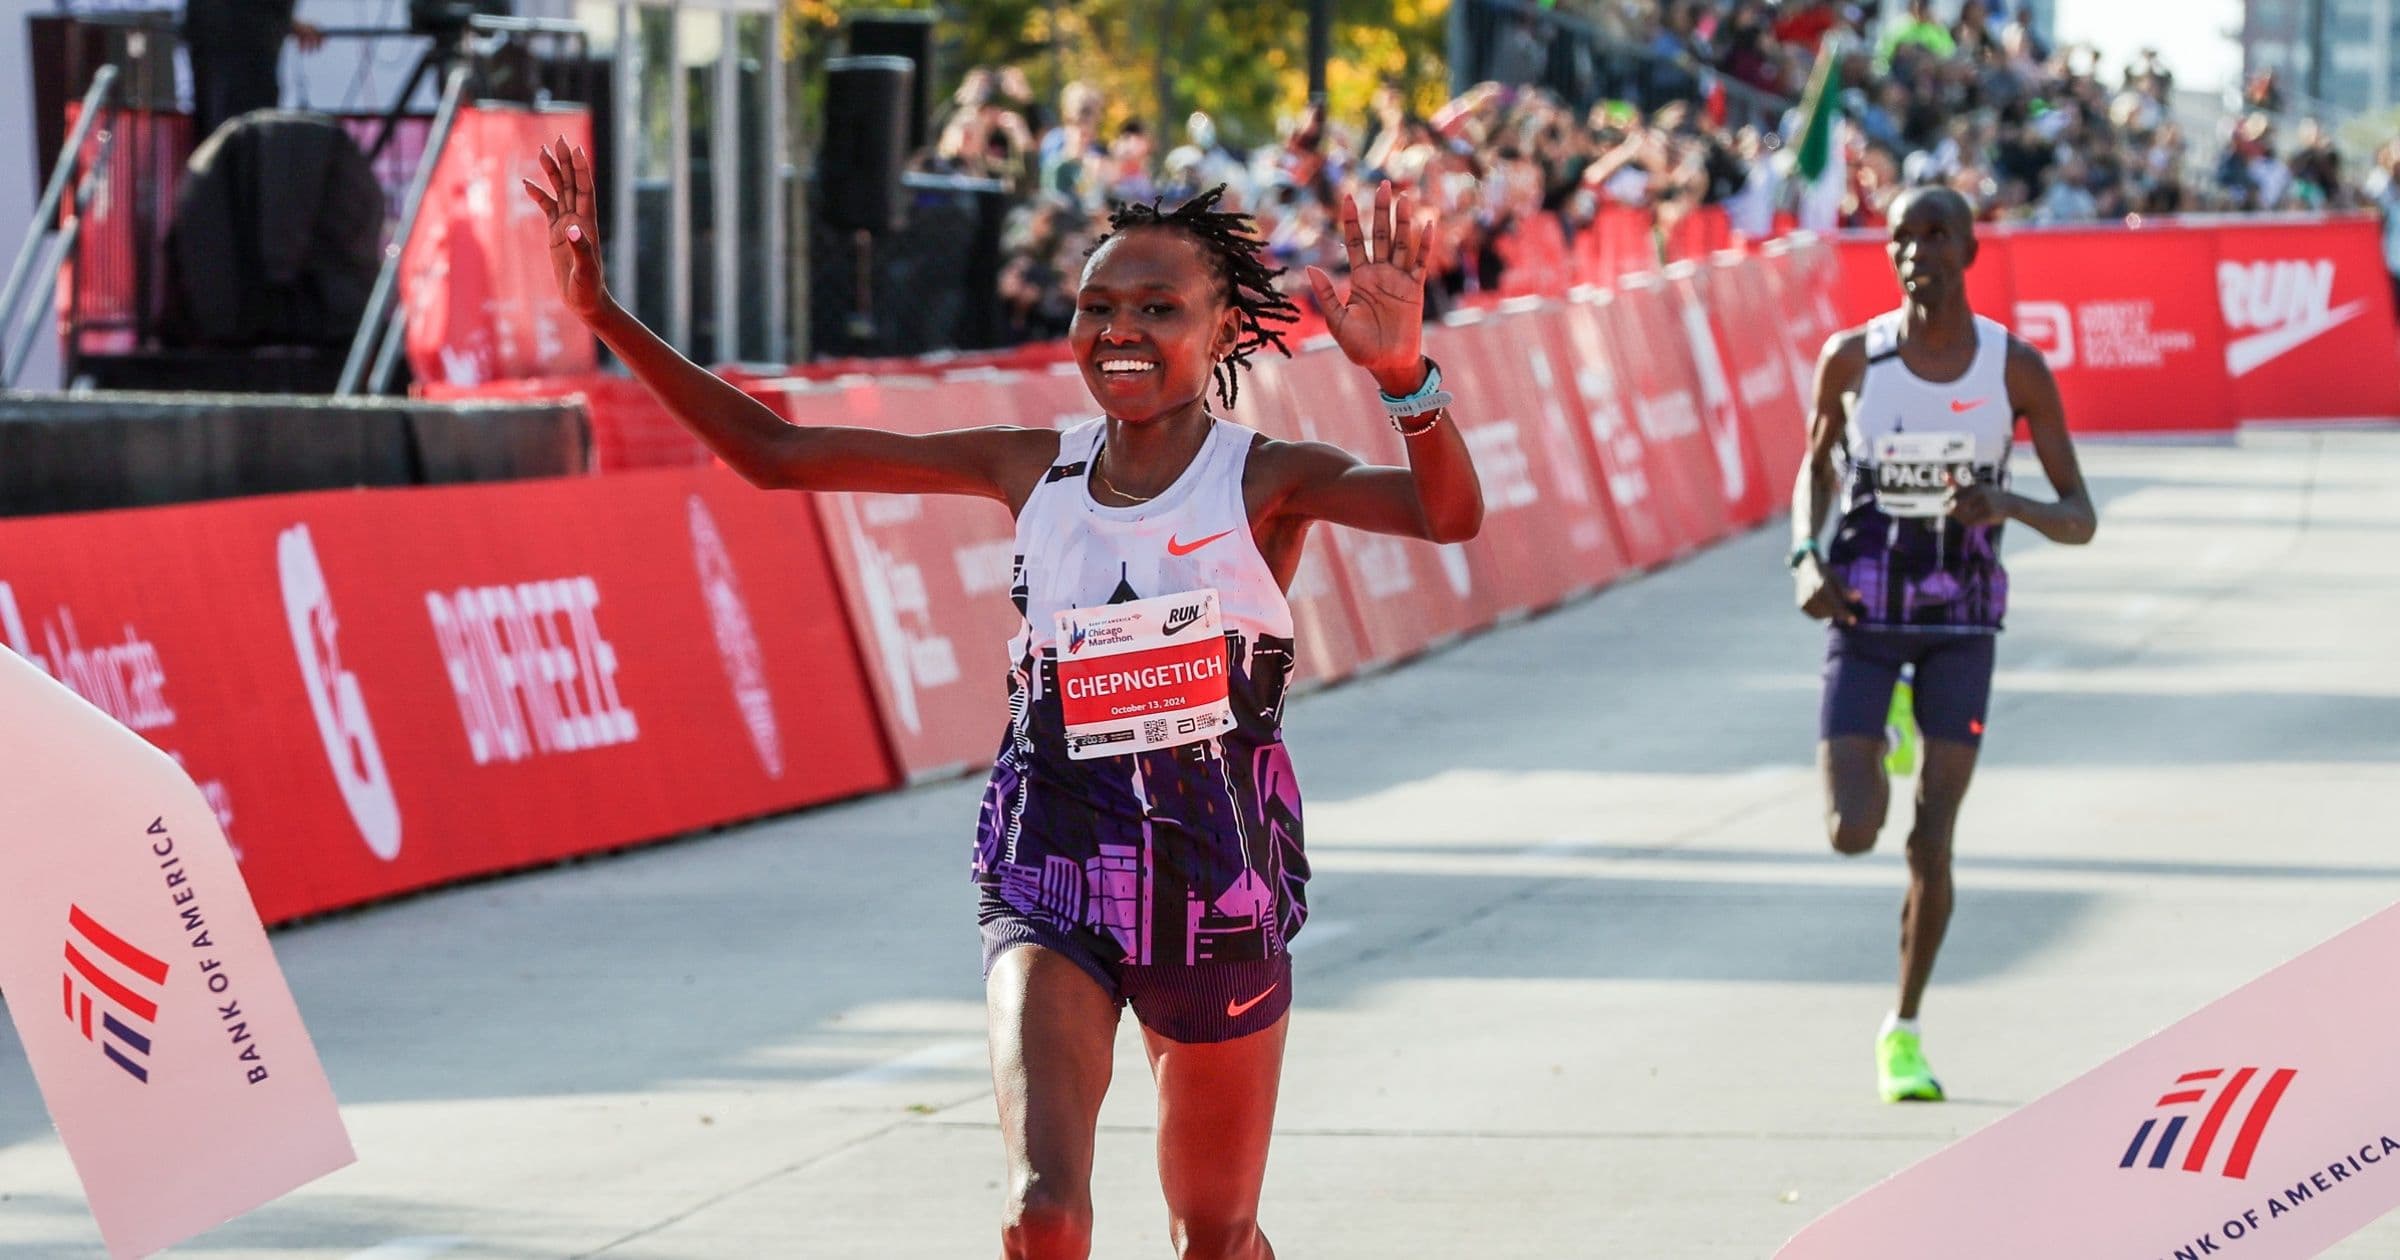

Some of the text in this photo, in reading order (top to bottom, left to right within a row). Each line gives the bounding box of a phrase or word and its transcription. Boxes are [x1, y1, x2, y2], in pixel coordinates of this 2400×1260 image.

[2216, 260, 2335, 329] RUN
[1168, 604, 1199, 623] RUN
[1088, 627, 1123, 637] Chicago
[1088, 635, 1134, 647] Marathon
[1067, 655, 1222, 699] CHEPNGETICH
[1111, 696, 1186, 715] October 13, 2024
[146, 816, 268, 1085] BANK OF AMERICA
[2222, 1208, 2260, 1240] OF
[2267, 1135, 2400, 1219] AMERICA
